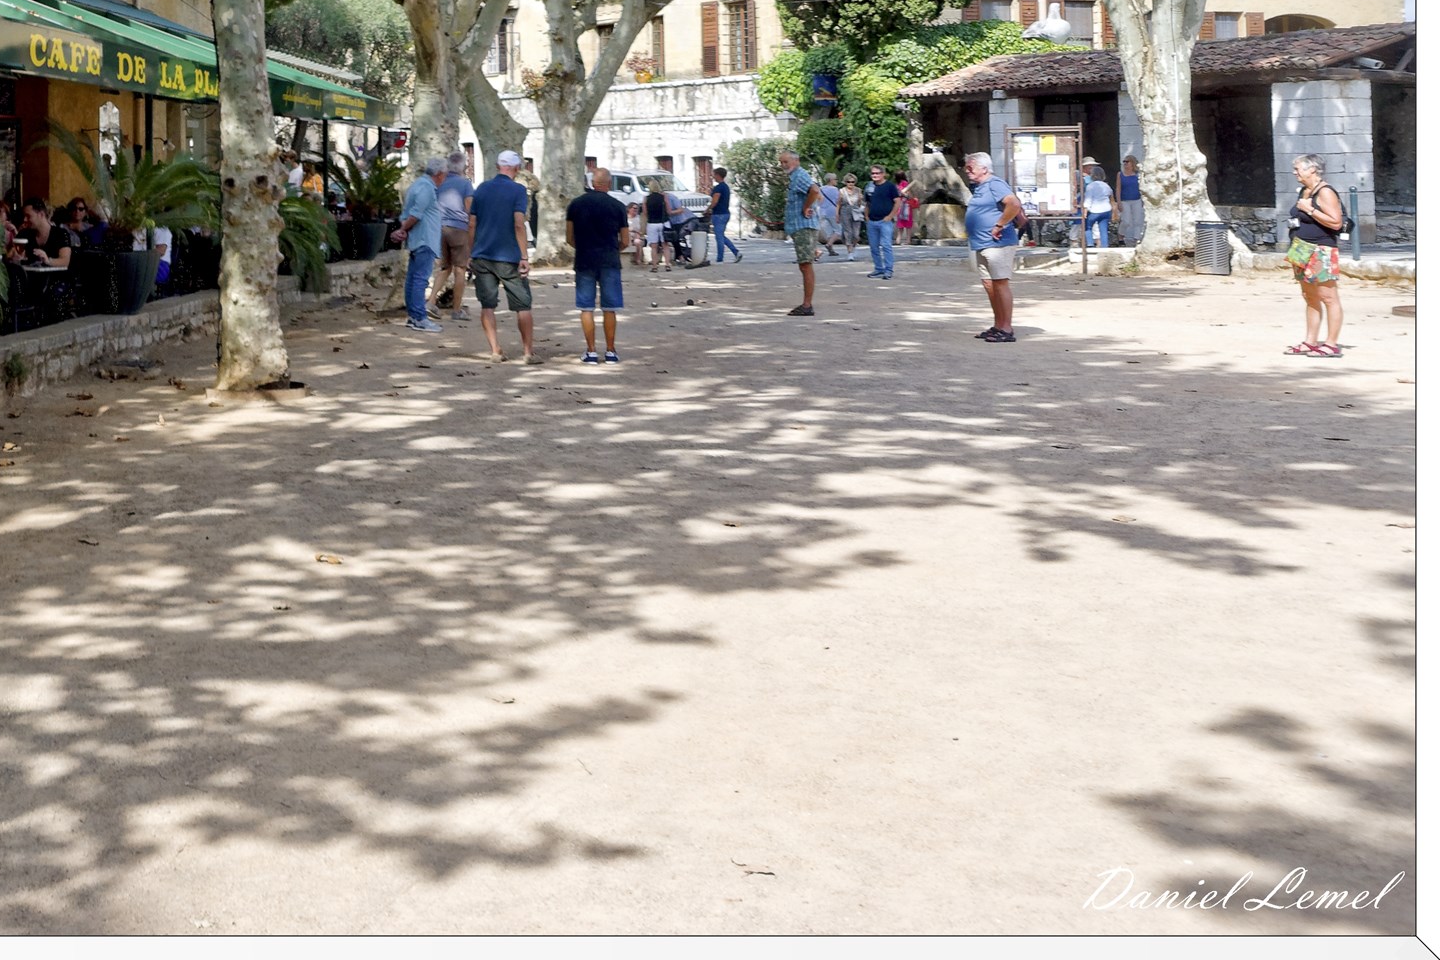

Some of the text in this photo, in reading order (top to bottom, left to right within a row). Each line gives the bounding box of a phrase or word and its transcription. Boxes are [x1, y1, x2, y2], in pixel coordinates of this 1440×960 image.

[29, 33, 101, 77] CAFE
[116, 52, 146, 85] DE
[160, 61, 187, 91] LA
